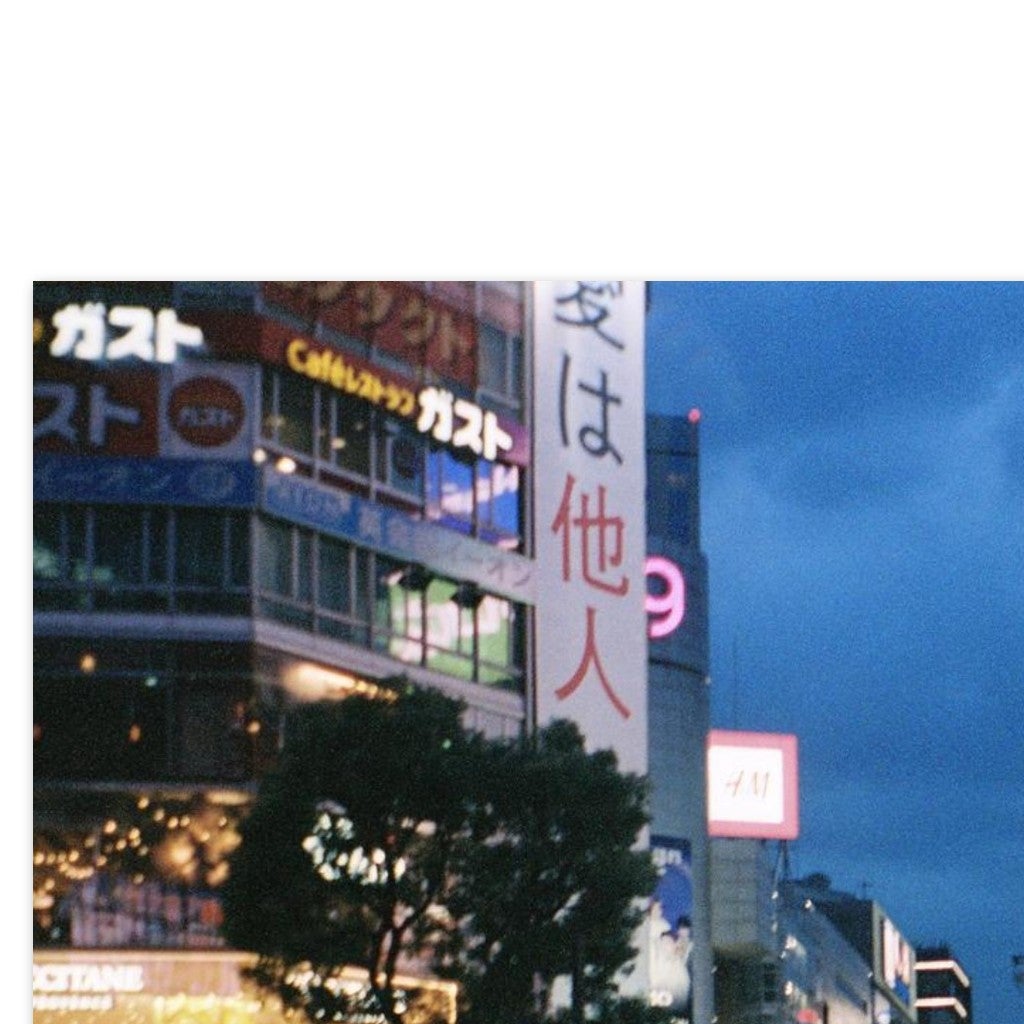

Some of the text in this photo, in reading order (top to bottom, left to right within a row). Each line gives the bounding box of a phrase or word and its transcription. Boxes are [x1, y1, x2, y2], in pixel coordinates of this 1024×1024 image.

[49, 302, 204, 363] ガスト
[417, 386, 513, 461] ガスト
